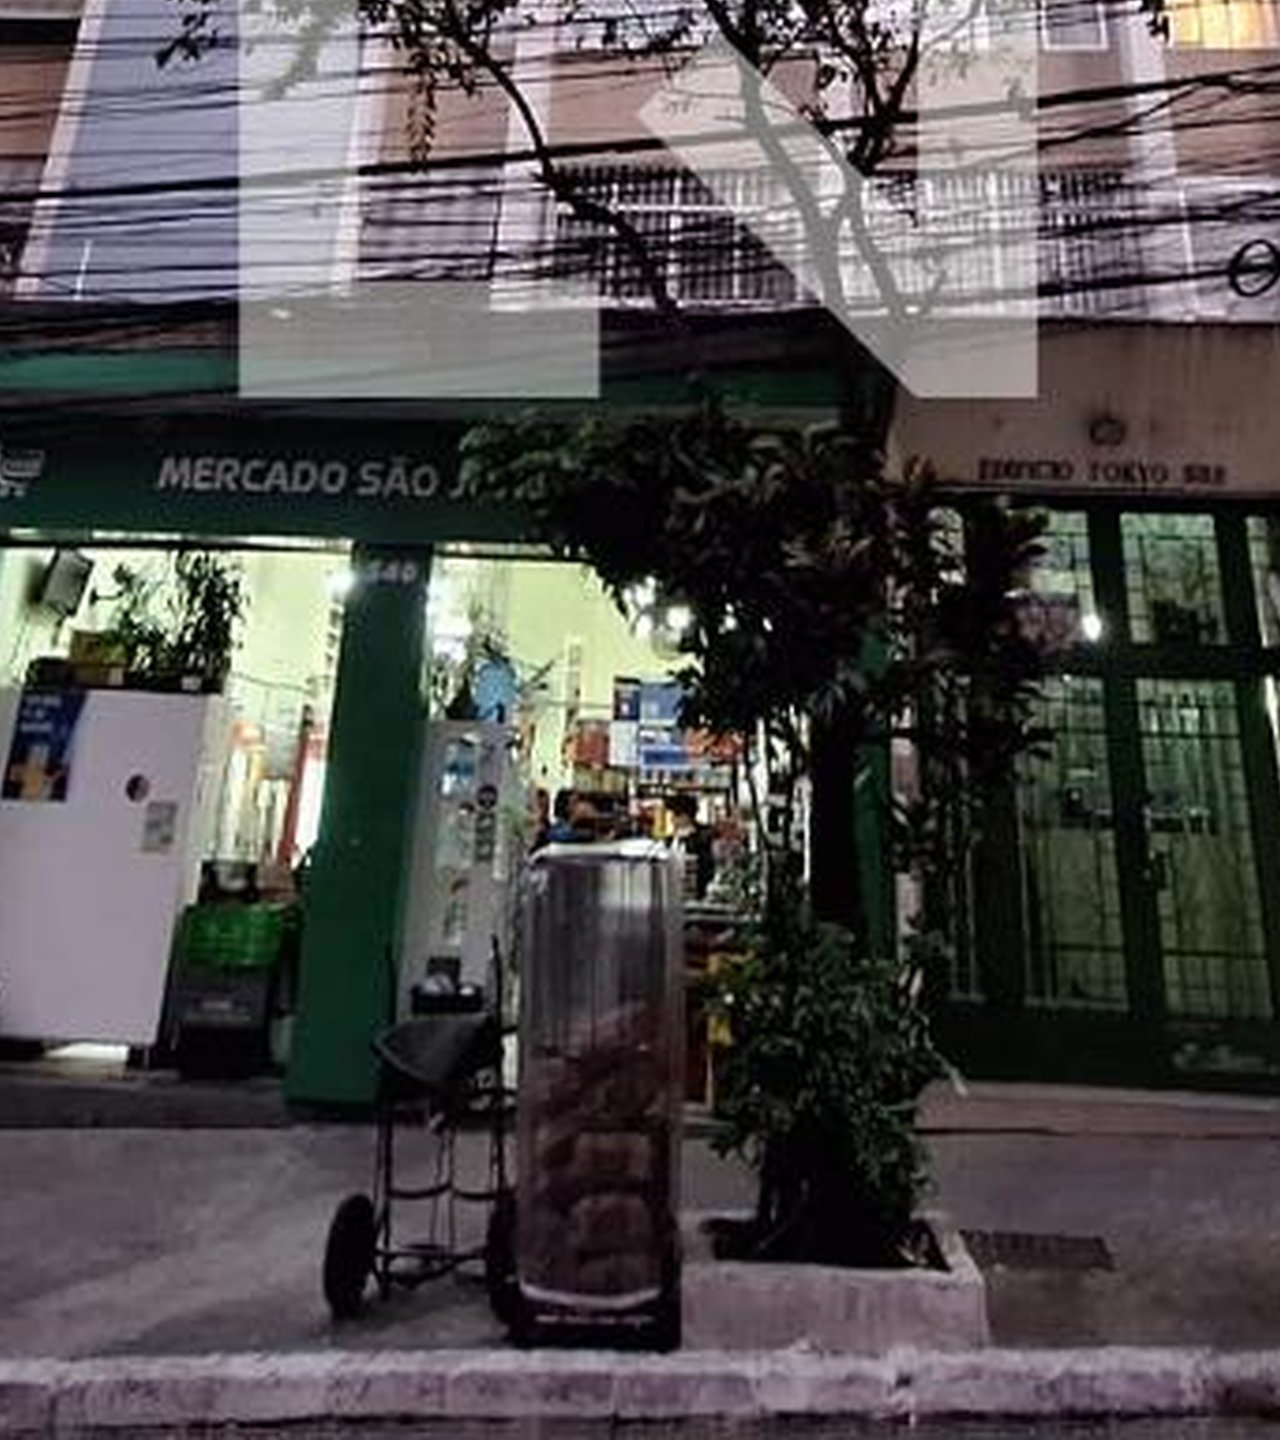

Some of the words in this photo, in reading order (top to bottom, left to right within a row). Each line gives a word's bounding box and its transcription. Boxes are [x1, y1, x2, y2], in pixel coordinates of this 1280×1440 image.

[158, 456, 349, 494] MERCADO
[356, 457, 439, 498] SÃO
[1088, 461, 1169, 483] TOKYO
